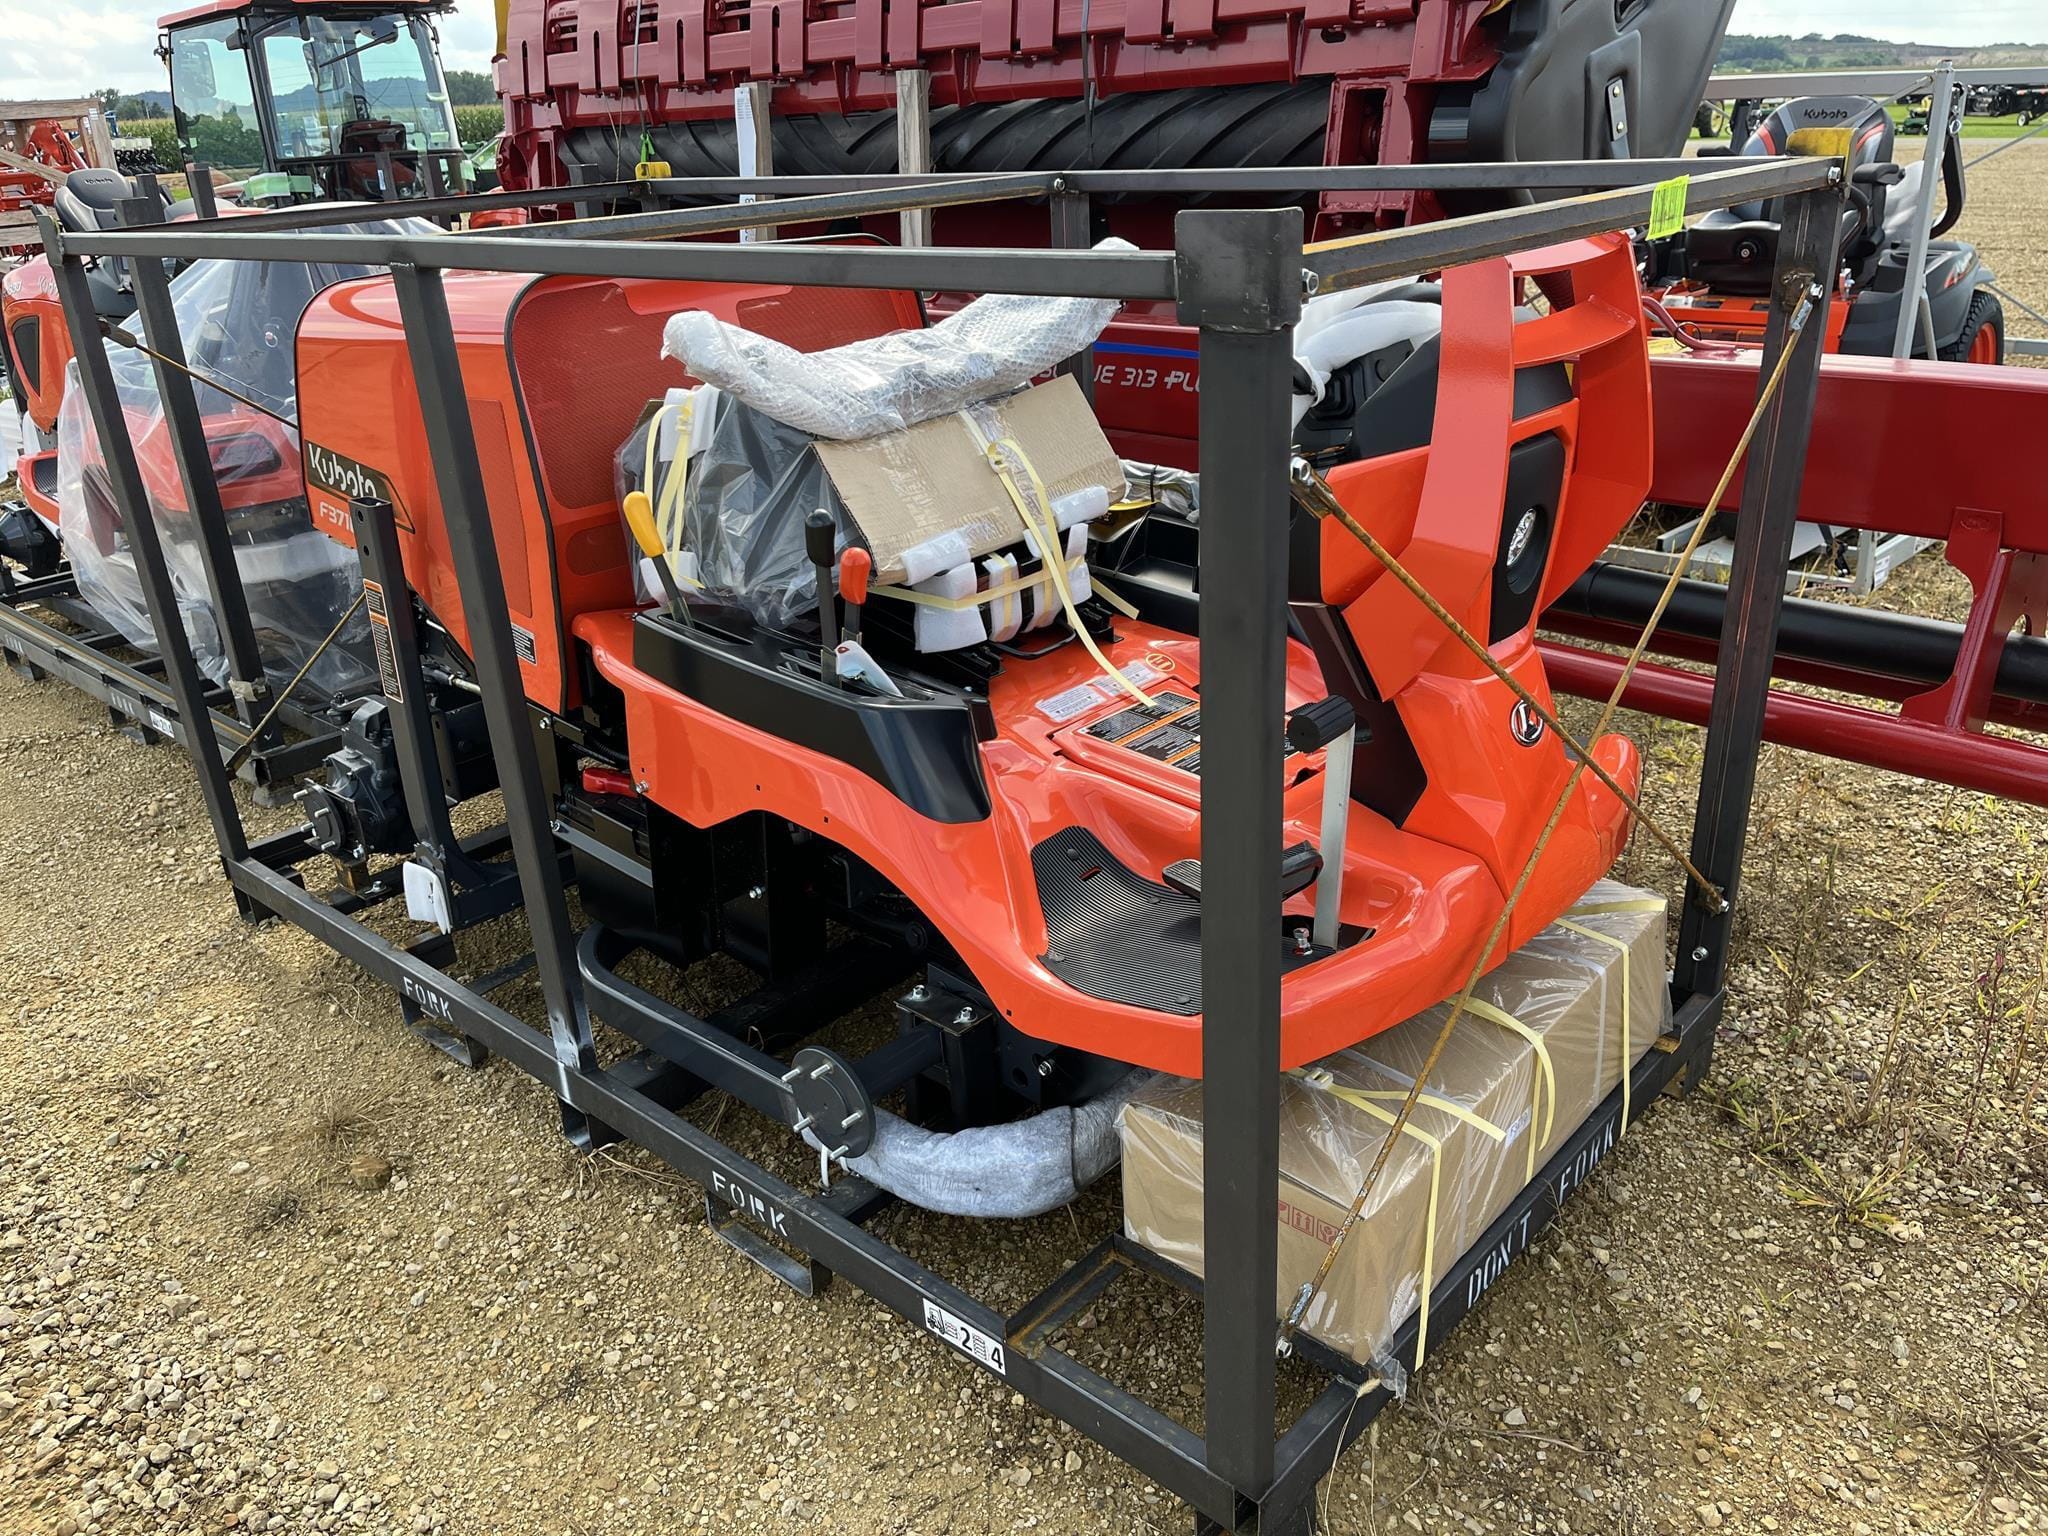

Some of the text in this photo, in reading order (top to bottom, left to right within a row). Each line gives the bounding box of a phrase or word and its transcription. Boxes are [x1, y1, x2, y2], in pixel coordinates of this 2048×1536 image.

[1803, 108, 1848, 120] Kubota
[1120, 366, 1158, 388] 313
[308, 443, 378, 498] Kubota
[319, 501, 355, 534] F371
[402, 976, 453, 1022] FORK
[1558, 1115, 1616, 1207] FORK
[711, 1170, 790, 1237] FORK
